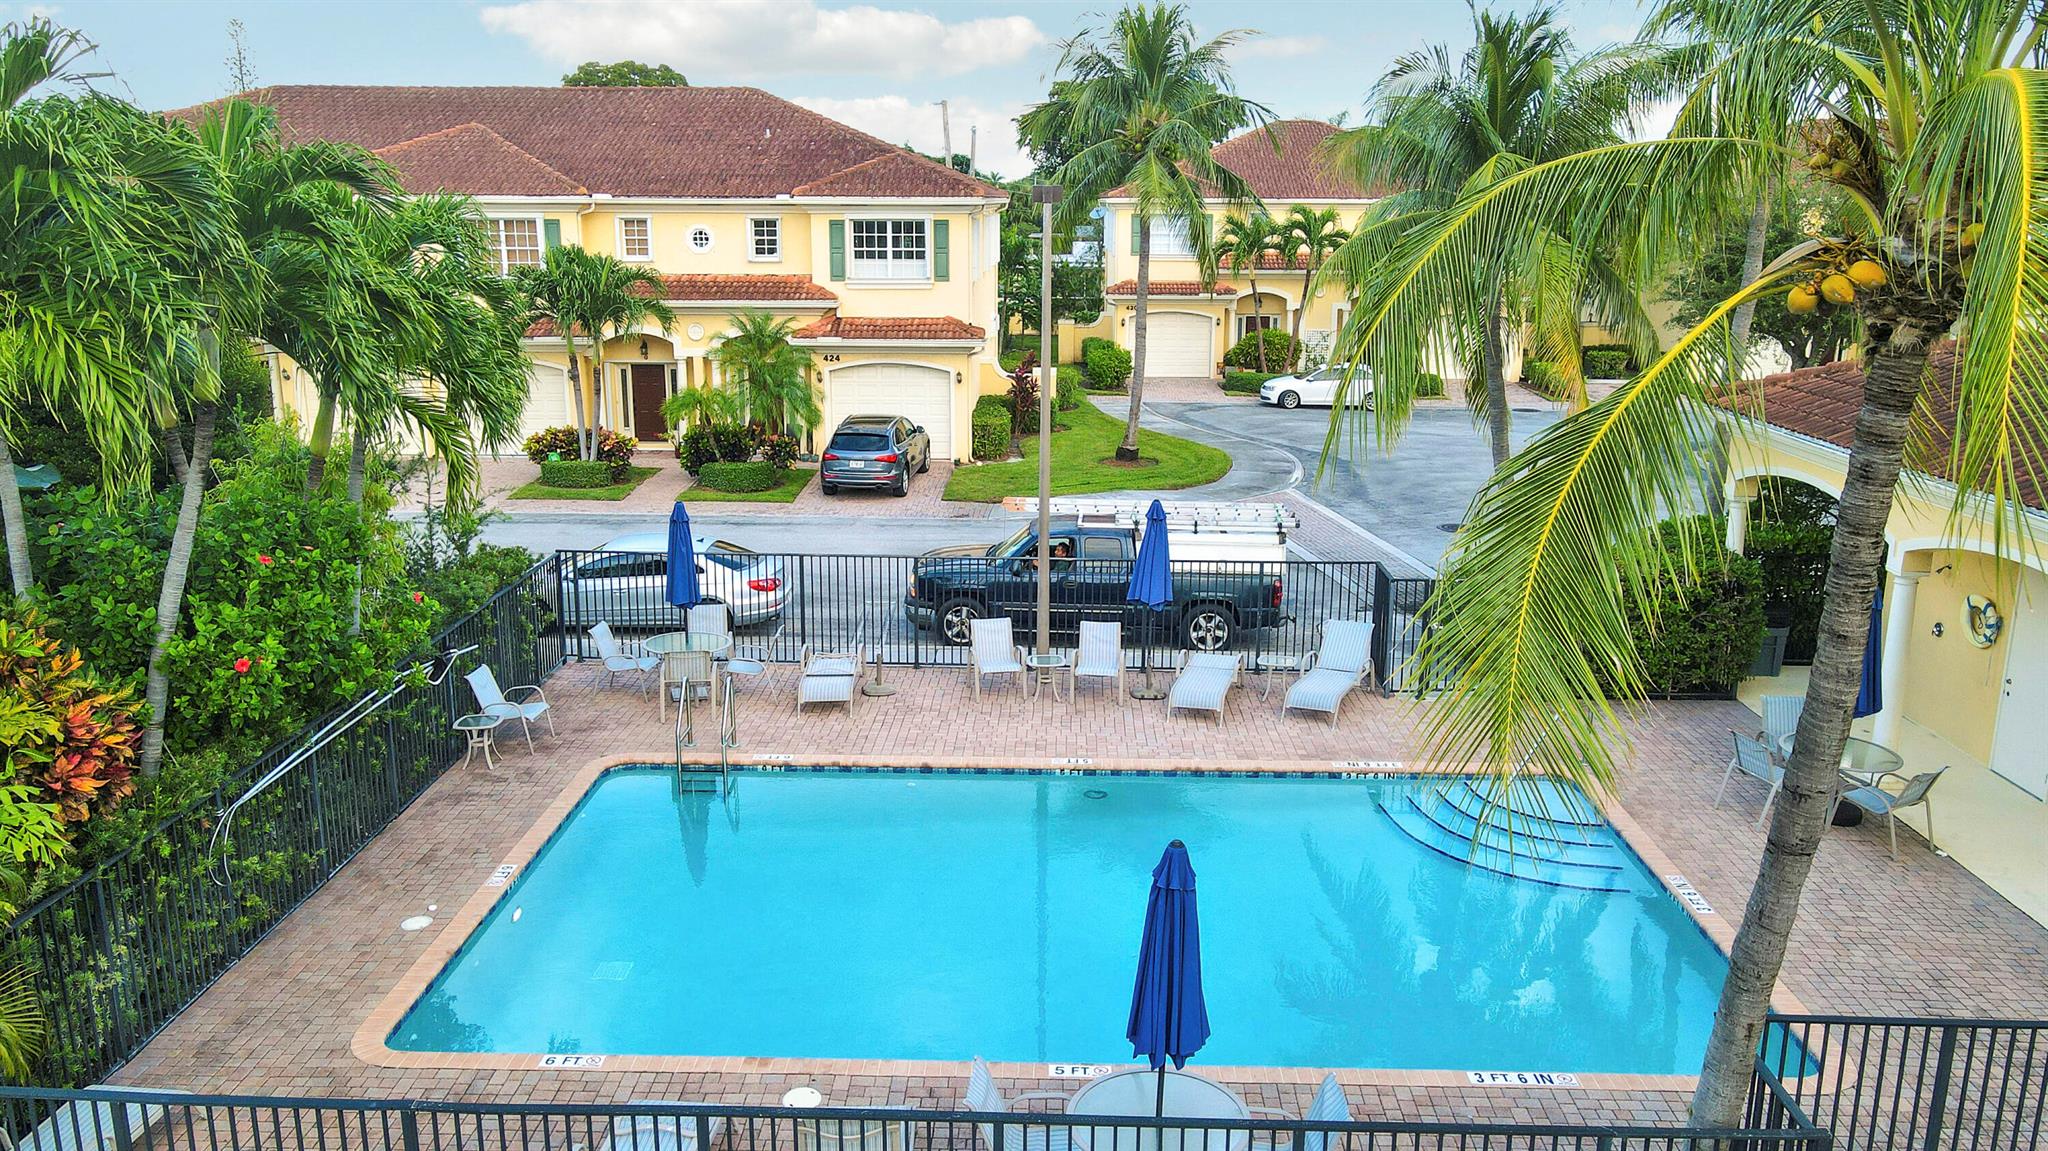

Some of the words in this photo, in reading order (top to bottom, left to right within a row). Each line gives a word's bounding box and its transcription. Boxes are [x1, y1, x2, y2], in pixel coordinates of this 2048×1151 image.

[823, 354, 841, 362] 424
[1383, 772, 1396, 780] IN
[545, 1056, 557, 1066] 6
[1055, 1066, 1065, 1075] 5
[1474, 1072, 1485, 1083] 3
[1517, 1073, 1529, 1084] 6
[1533, 1073, 1555, 1085] IN
